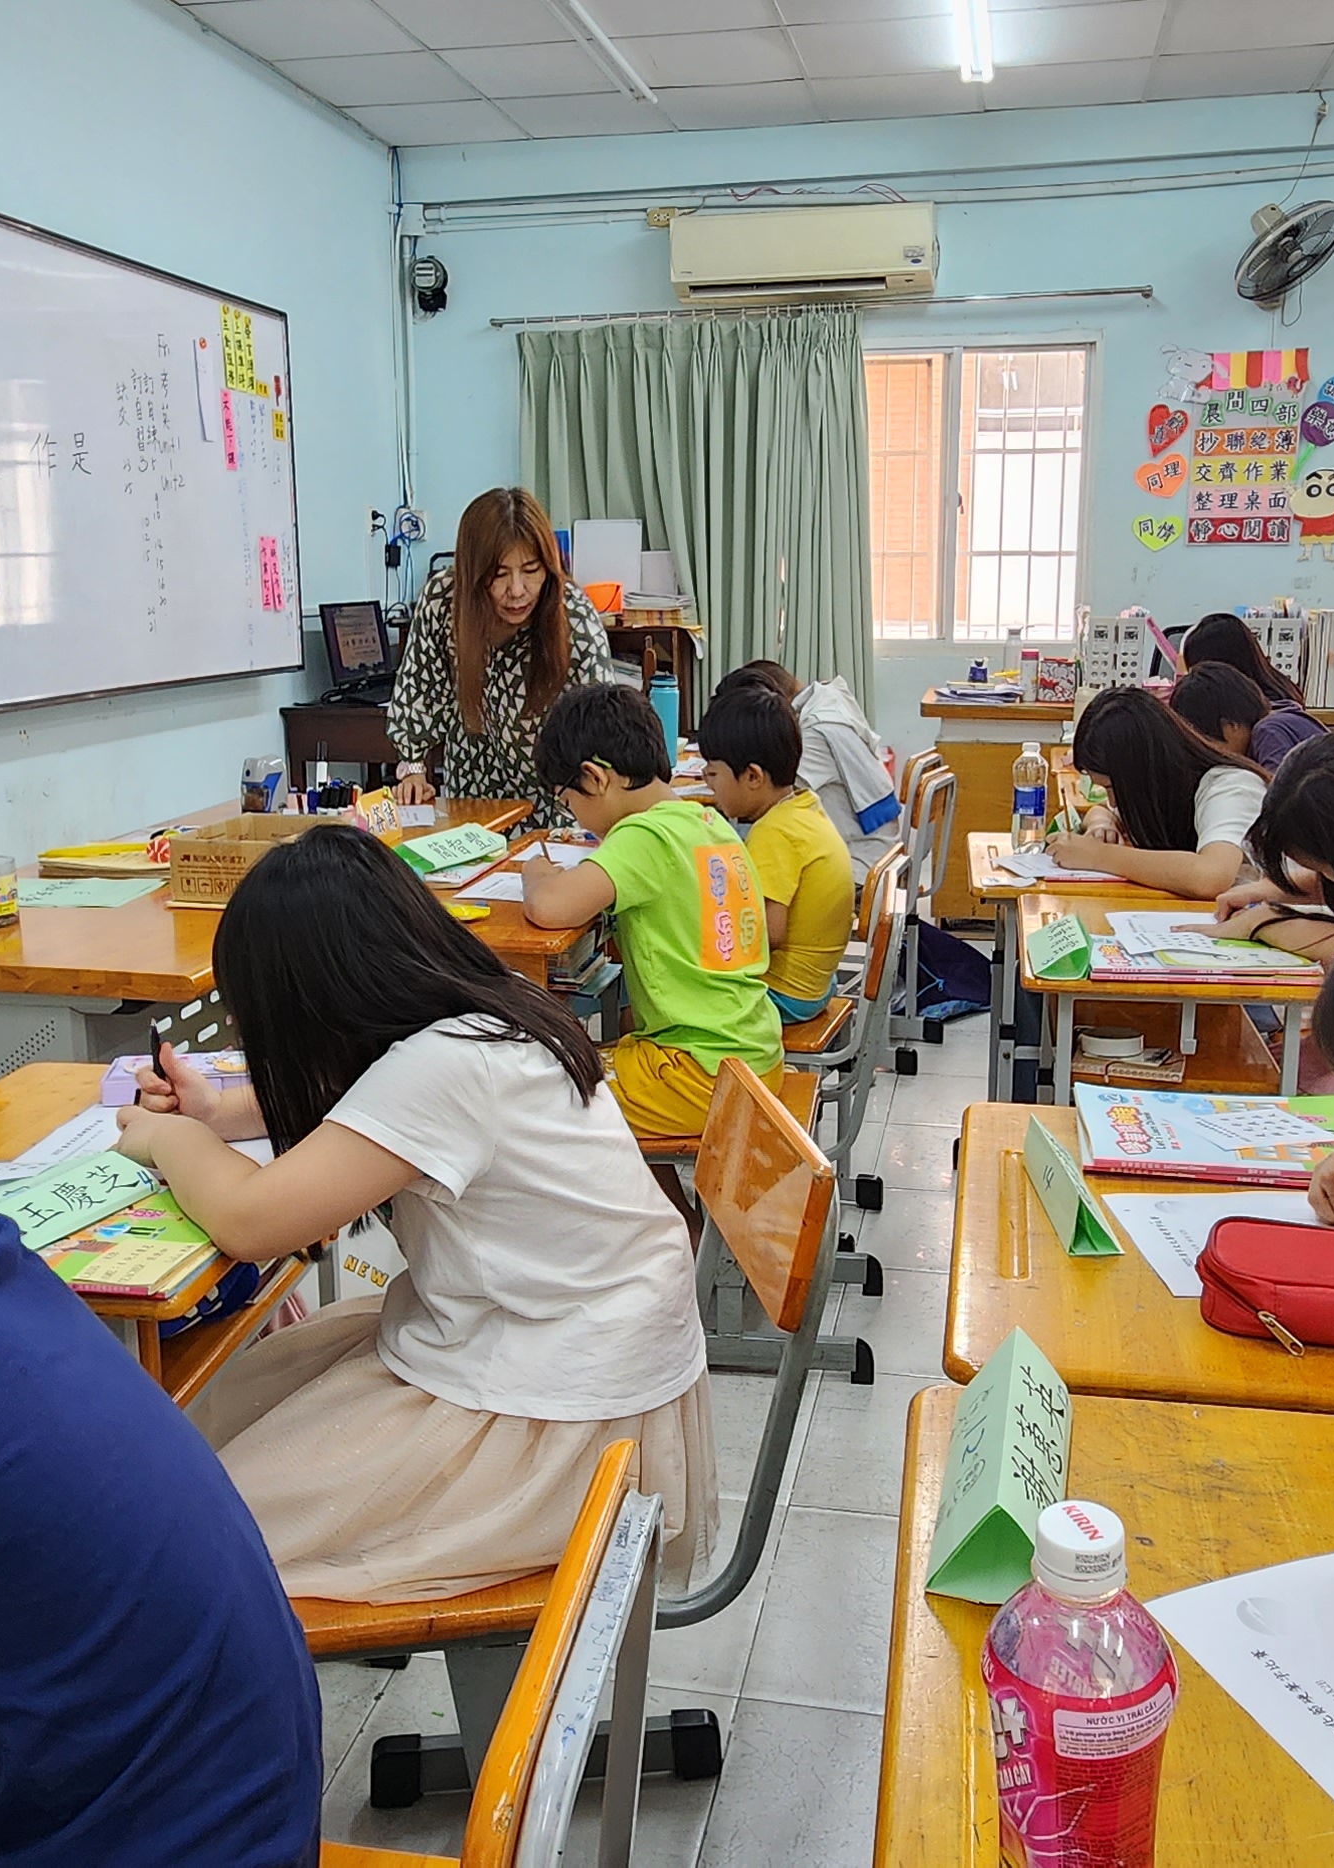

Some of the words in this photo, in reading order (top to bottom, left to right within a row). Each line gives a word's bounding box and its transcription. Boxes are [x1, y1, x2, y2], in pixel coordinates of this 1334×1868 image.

[1203, 389, 1298, 425] 晨間四部
[1197, 430, 1296, 452] 抄聯絡簿
[1146, 460, 1182, 491] 同理
[1195, 460, 1289, 483] 交齊作業
[1194, 490, 1287, 512] 整理桌面
[1190, 518, 1289, 541] 靜心閱讀
[1042, 1165, 1055, 1191] 14
[17, 1164, 140, 1235] 玉慶芝
[136, 1170, 155, 1192] 4
[343, 1254, 389, 1288] NEW
[1062, 1504, 1105, 1541] KIRIN
[1126, 1709, 1144, 1721] TRÁI
[1014, 1761, 1032, 1787] CÂY
